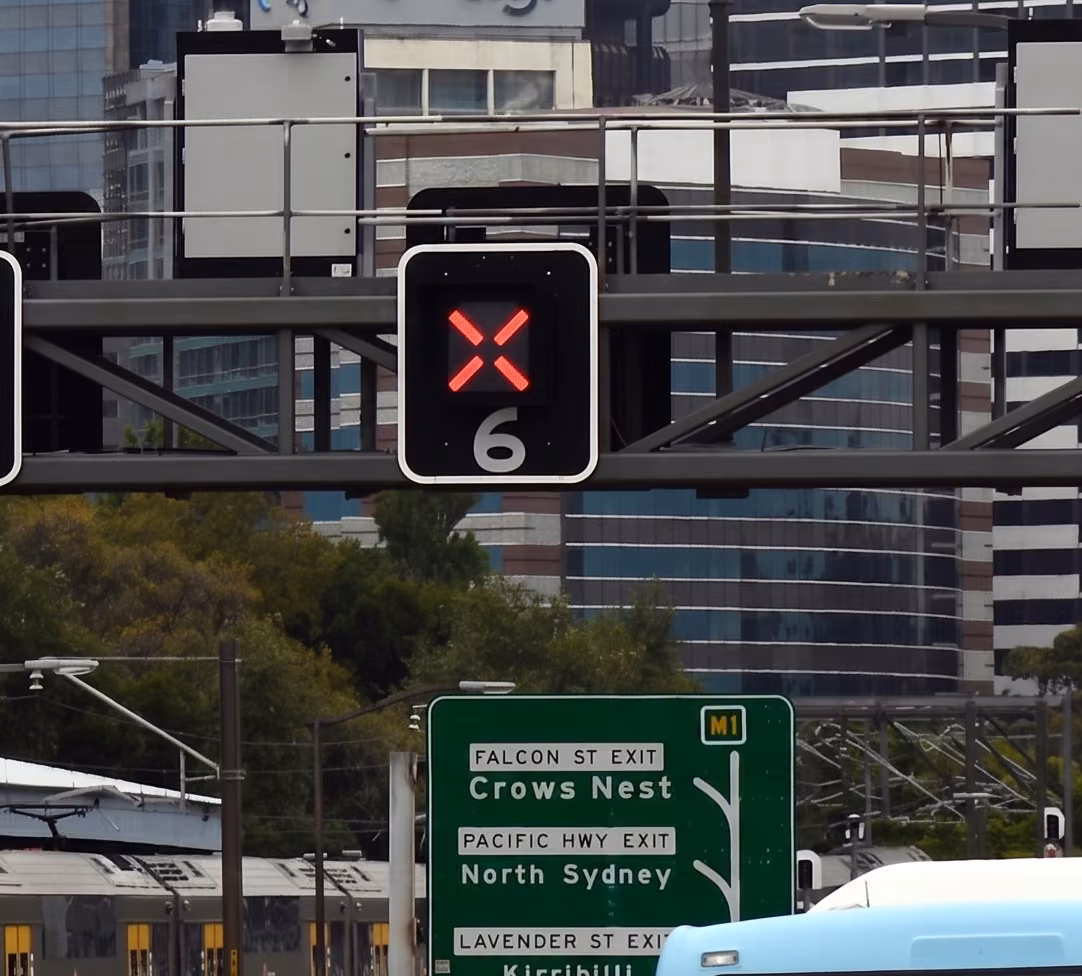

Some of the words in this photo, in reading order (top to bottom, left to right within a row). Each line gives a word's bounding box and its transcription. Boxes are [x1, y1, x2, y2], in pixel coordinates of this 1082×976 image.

[473, 406, 526, 473] 6
[710, 714, 738, 736] M1
[474, 748, 560, 766] FALCON
[573, 748, 599, 766] ST
[610, 748, 658, 766] EXIT
[469, 775, 576, 800] Crows
[592, 775, 672, 800] Nest
[462, 832, 550, 850] PACIFIC
[561, 832, 609, 850] HWY
[622, 832, 670, 850] EXIT
[461, 863, 544, 885] North
[563, 863, 672, 890] Sydney
[459, 932, 578, 950] LAVENDER
[589, 932, 615, 950] ST
[627, 933, 669, 949] EXI
